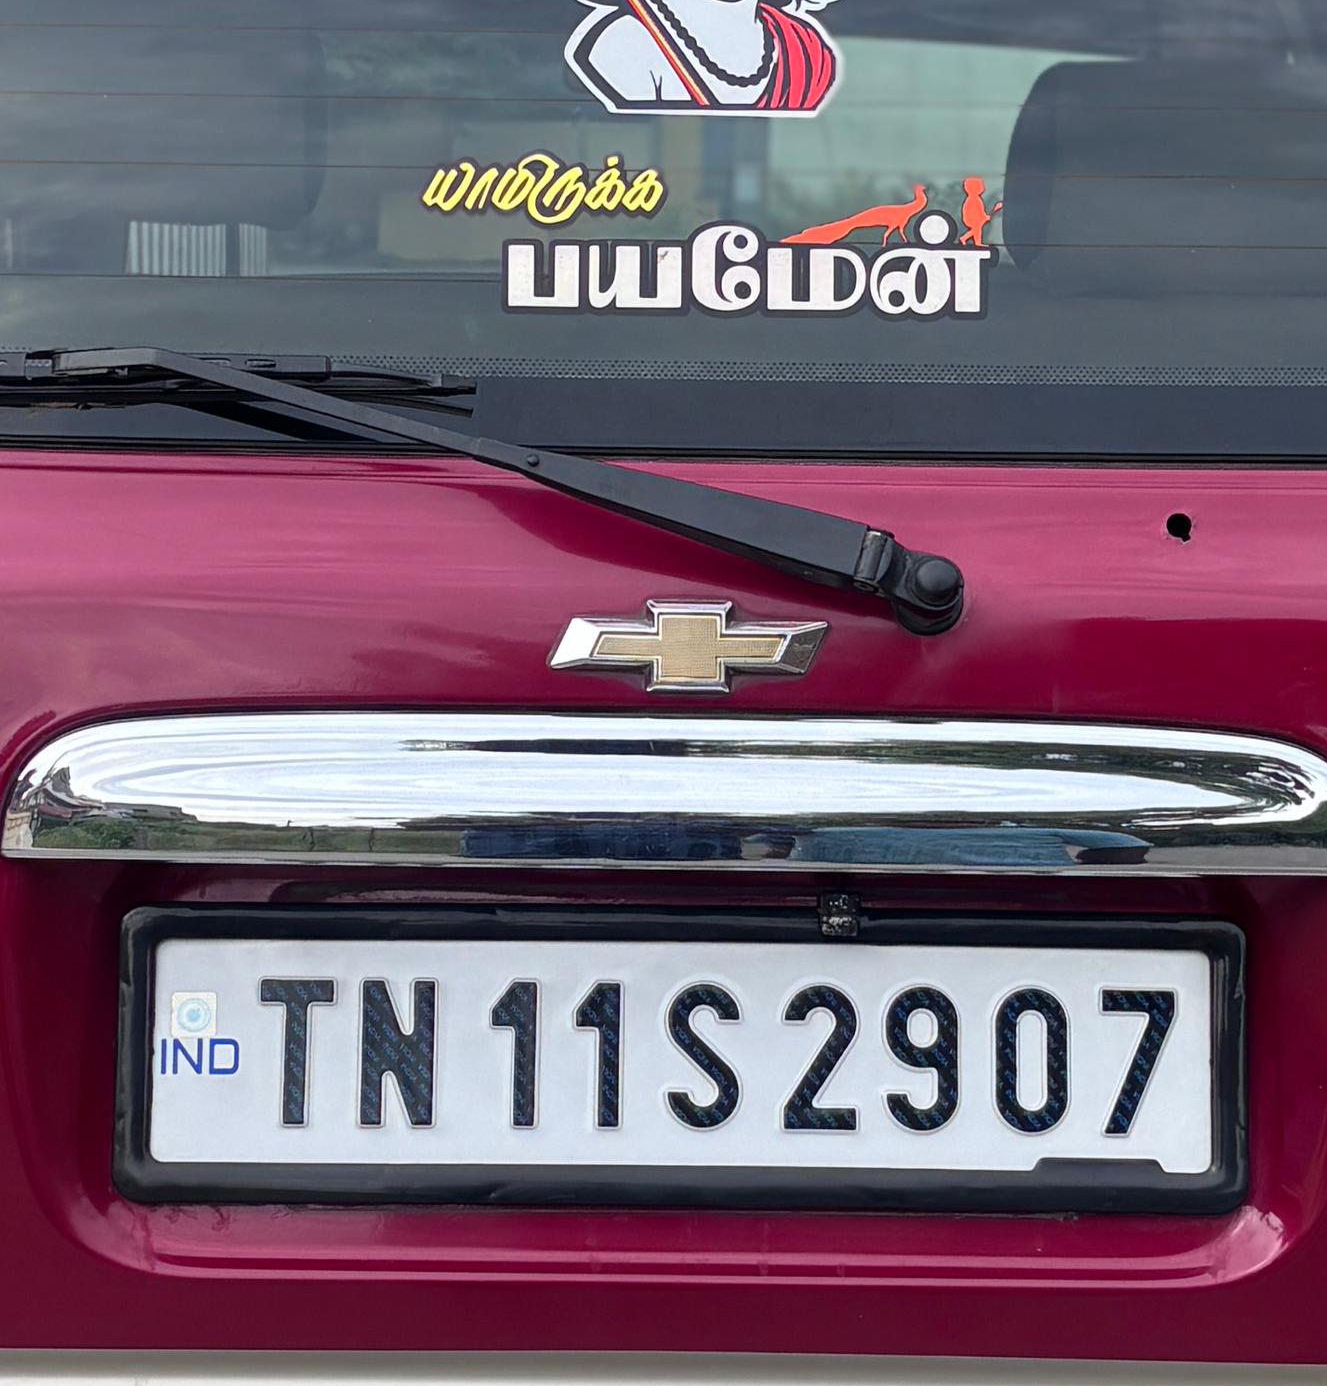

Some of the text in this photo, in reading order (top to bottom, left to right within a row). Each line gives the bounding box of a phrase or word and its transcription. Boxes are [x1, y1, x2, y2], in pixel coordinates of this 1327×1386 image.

[422, 153, 663, 224] யாமிருக்க
[506, 213, 992, 315] பயமேன்
[160, 1038, 240, 1075] IND
